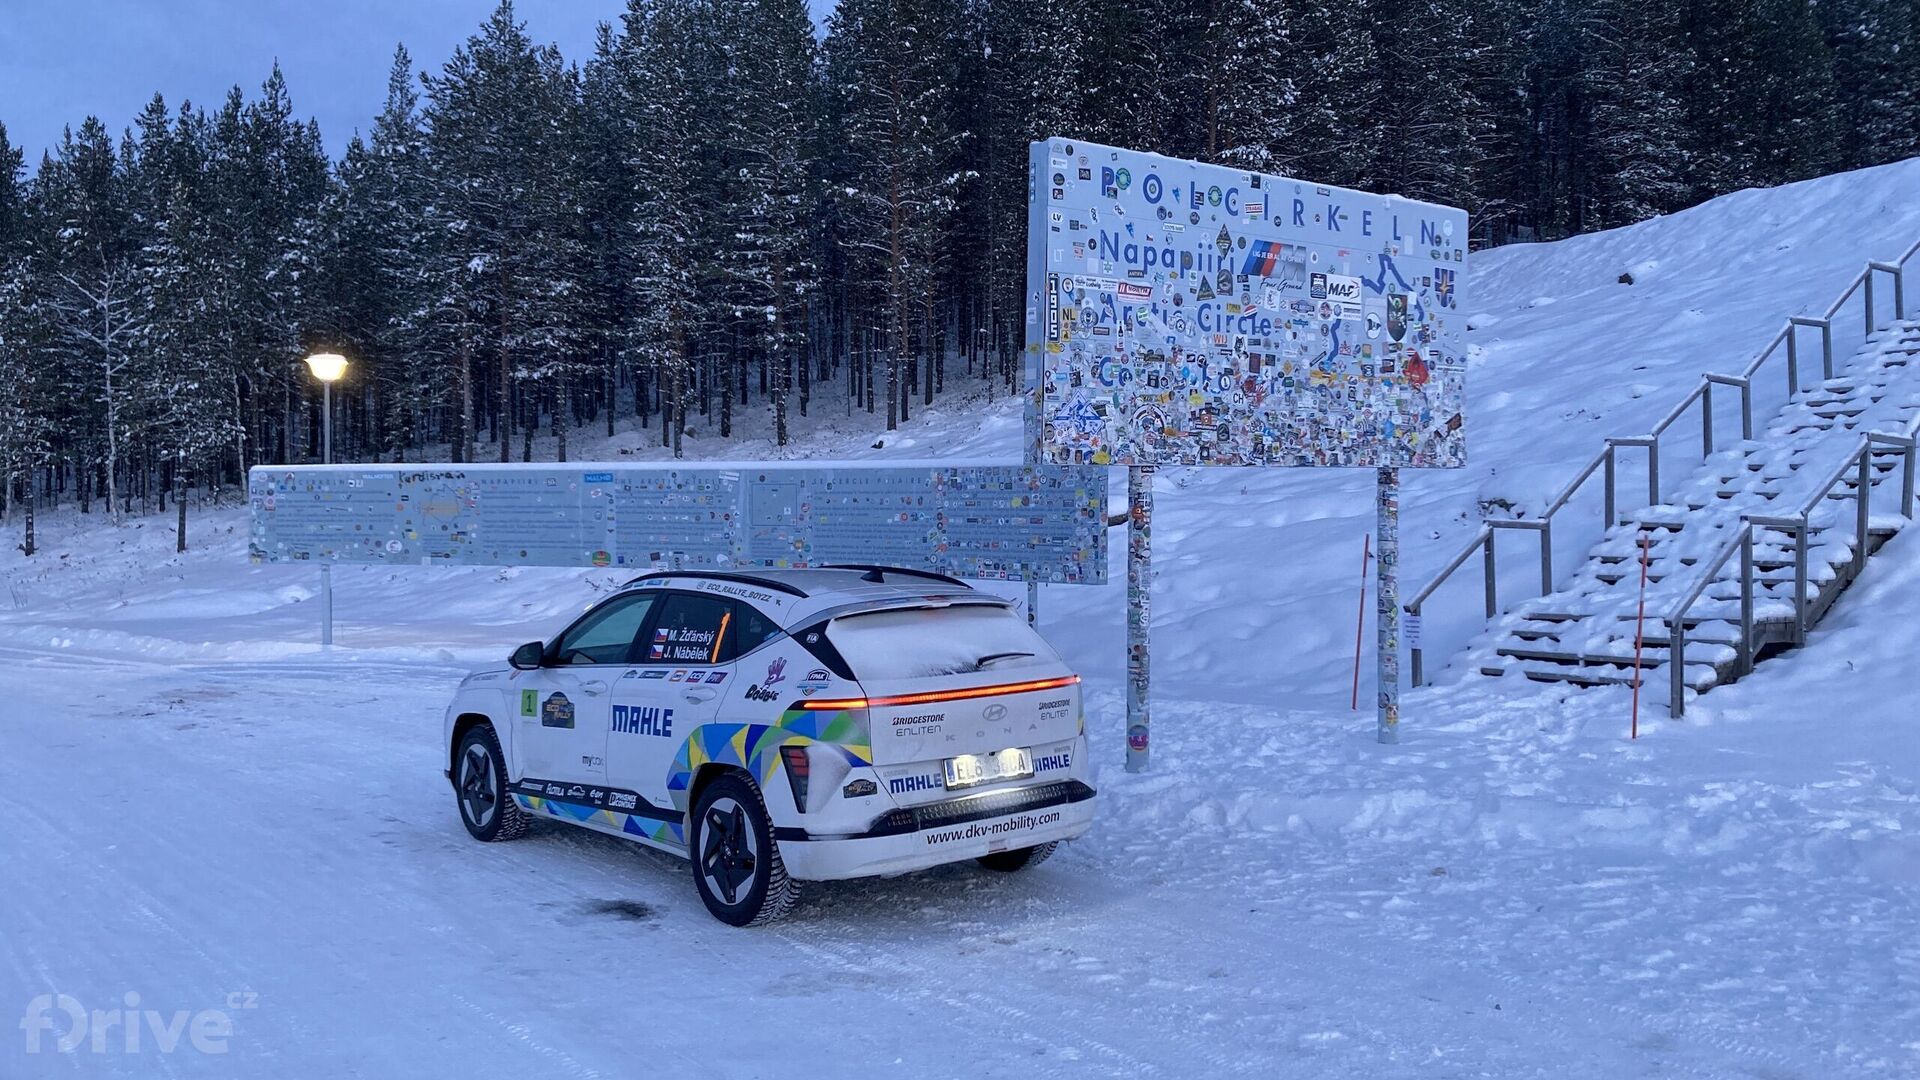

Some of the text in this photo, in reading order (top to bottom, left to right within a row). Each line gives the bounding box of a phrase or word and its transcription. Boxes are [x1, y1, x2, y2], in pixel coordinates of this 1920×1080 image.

[1053, 213, 1062, 221] LV
[1101, 229, 1234, 278] Napapiiri
[1050, 280, 1058, 338] 1905
[1062, 309, 1075, 320] NL
[1197, 303, 1271, 336] Circle
[1233, 393, 1244, 404] CH
[667, 631, 678, 642] M.
[663, 645, 708, 660] J. Nábělek
[526, 695, 532, 712] 1
[612, 705, 674, 737] MAHLE
[892, 714, 945, 726] BRIDGESTONE
[896, 725, 942, 737] ENLITEN
[945, 723, 1038, 742] KONA
[1034, 753, 1070, 773] MAHLE
[890, 773, 943, 794] MAHLE
[926, 811, 1060, 845] www.dkv-mobility.com
